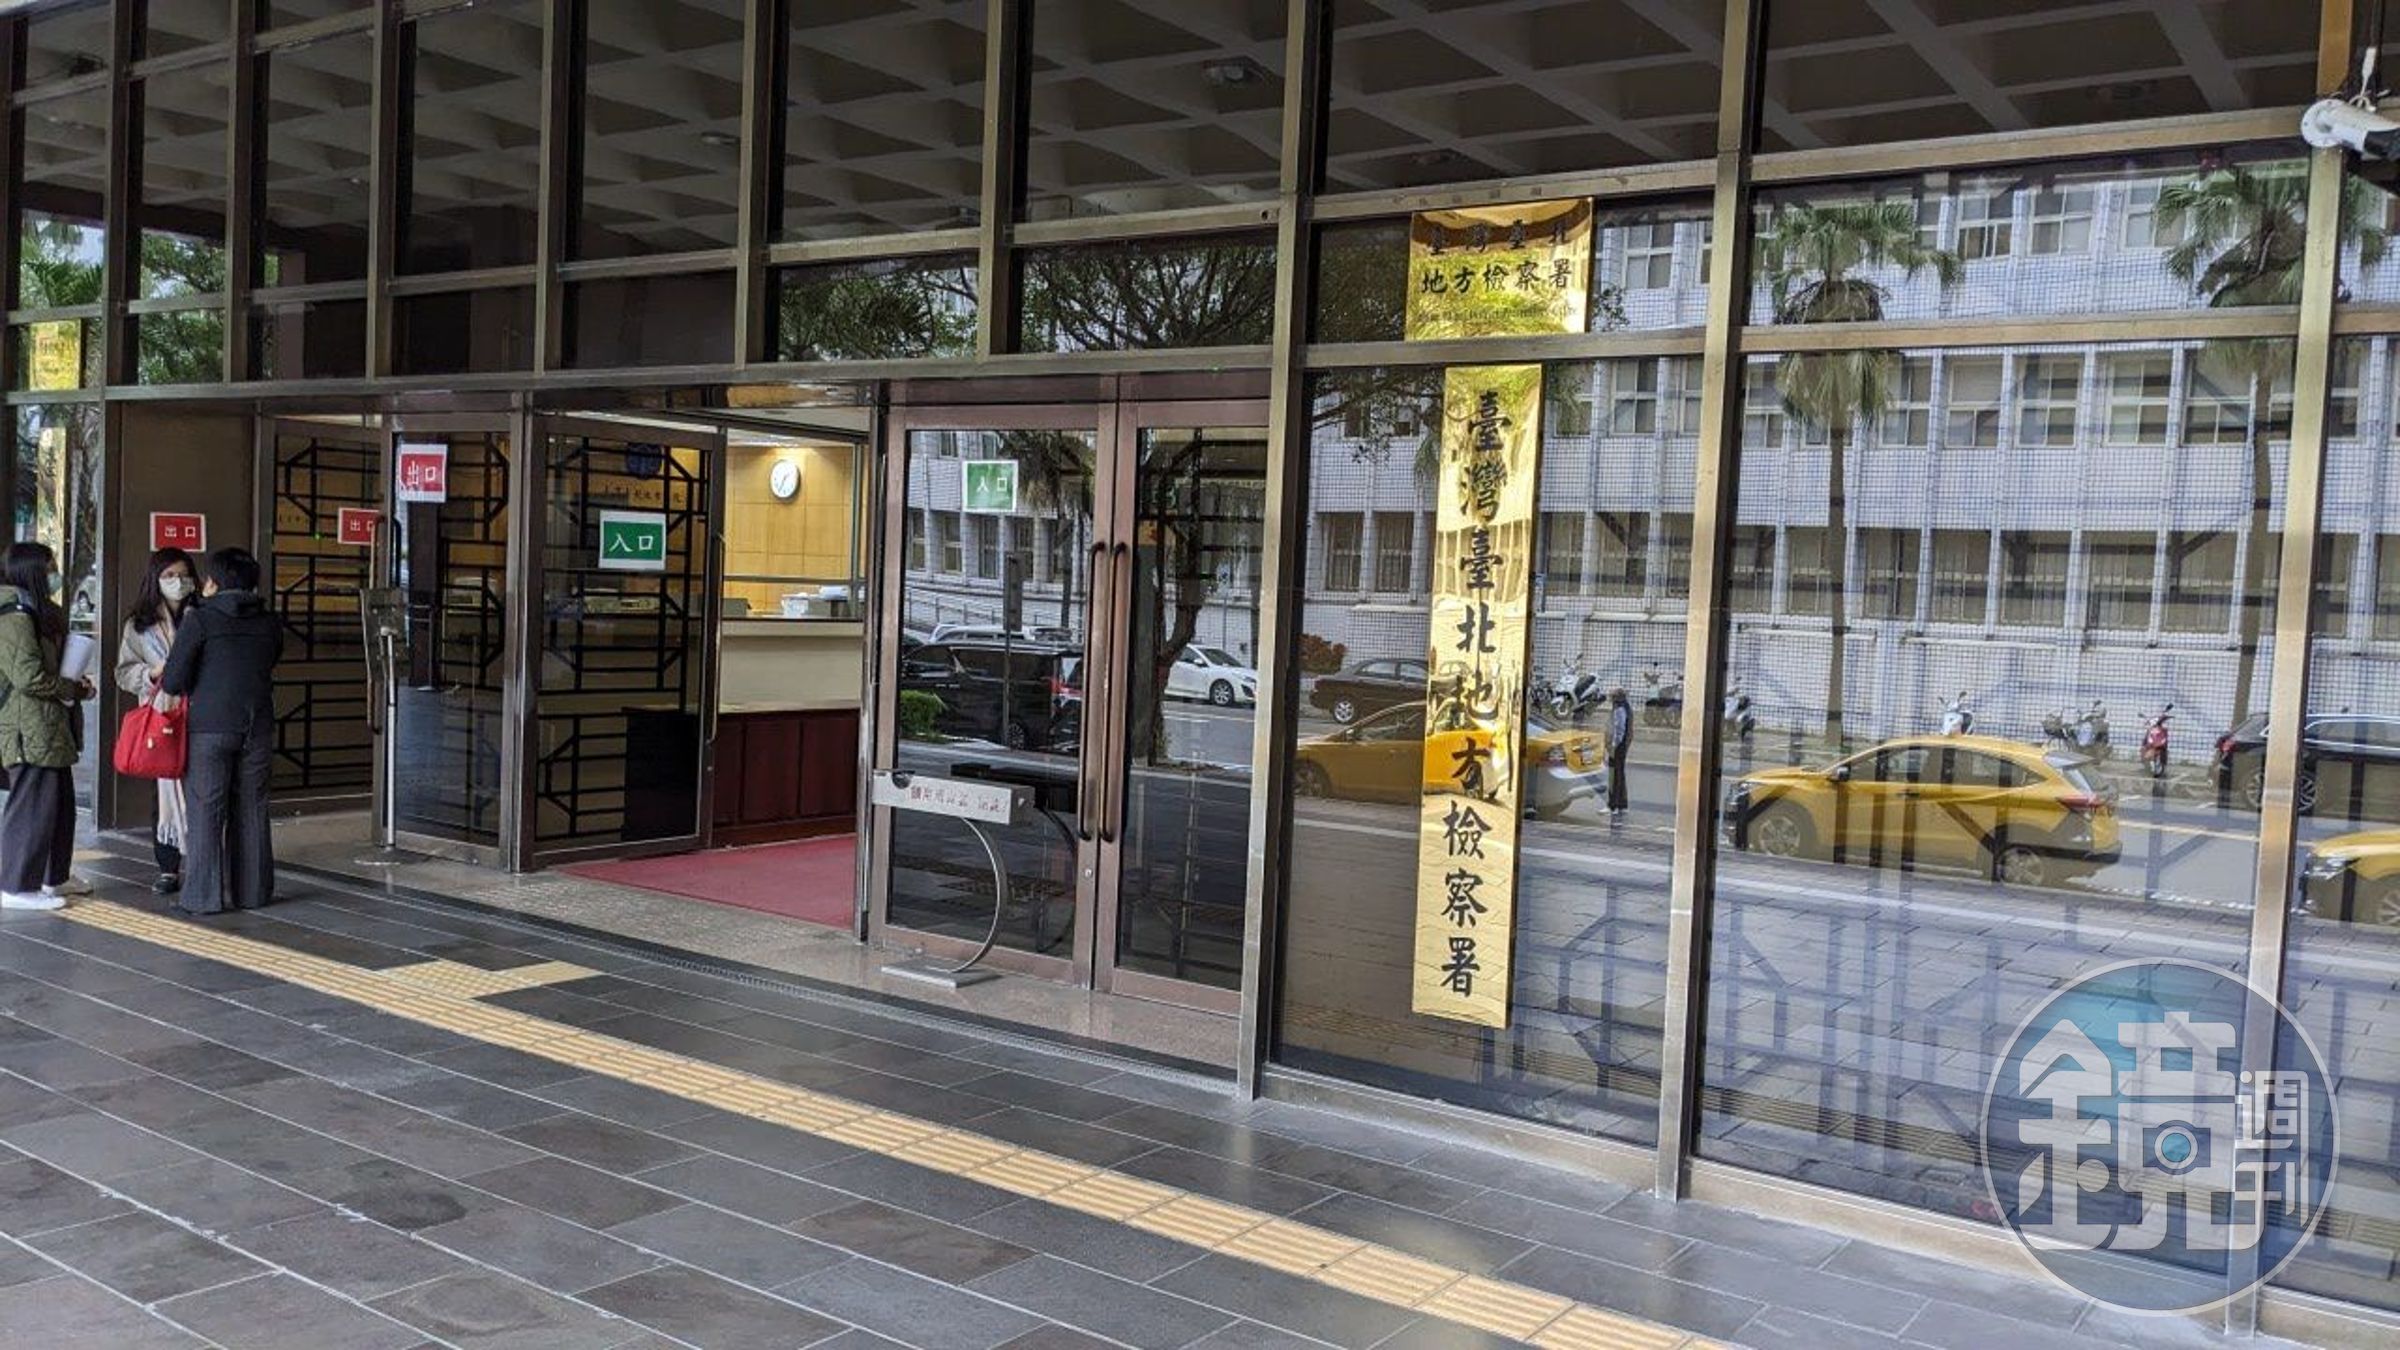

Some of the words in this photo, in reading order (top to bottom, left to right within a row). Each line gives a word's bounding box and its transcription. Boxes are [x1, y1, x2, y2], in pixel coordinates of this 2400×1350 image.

[1421, 258, 1573, 294] 地方檢察署
[407, 460, 437, 487] 出口
[976, 475, 1008, 493] 入口
[164, 525, 196, 538] 出口
[608, 532, 654, 552] 入口
[1440, 391, 1513, 998] 臺灣臺北地方檢察署
